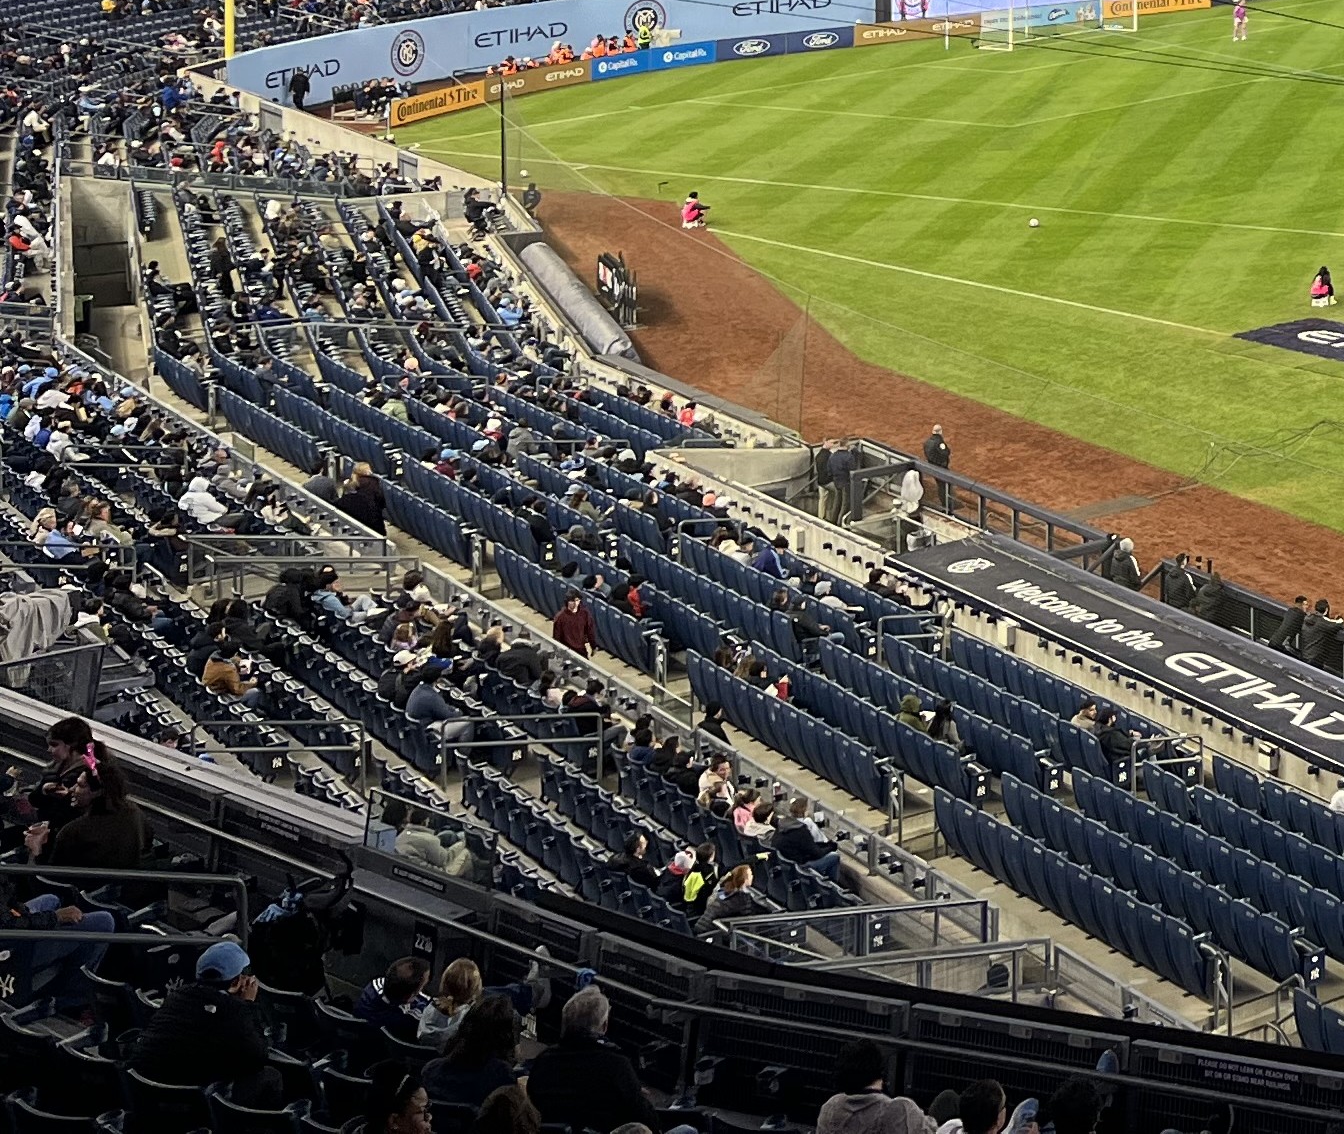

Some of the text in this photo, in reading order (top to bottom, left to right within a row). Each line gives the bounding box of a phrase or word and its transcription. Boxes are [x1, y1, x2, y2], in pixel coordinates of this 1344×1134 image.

[932, 20, 974, 32] ETIHAD
[475, 22, 568, 47] ETIHAD
[808, 34, 834, 47] Ford
[863, 27, 906, 40] ETIHAD
[738, 40, 765, 54] Ford
[674, 49, 707, 61] Capital Rx
[545, 68, 584, 82] ETIHAD
[398, 88, 477, 121] Continental Tire
[996, 577, 1088, 625] Welcome
[1085, 613, 1114, 634] to
[1111, 620, 1164, 652] the
